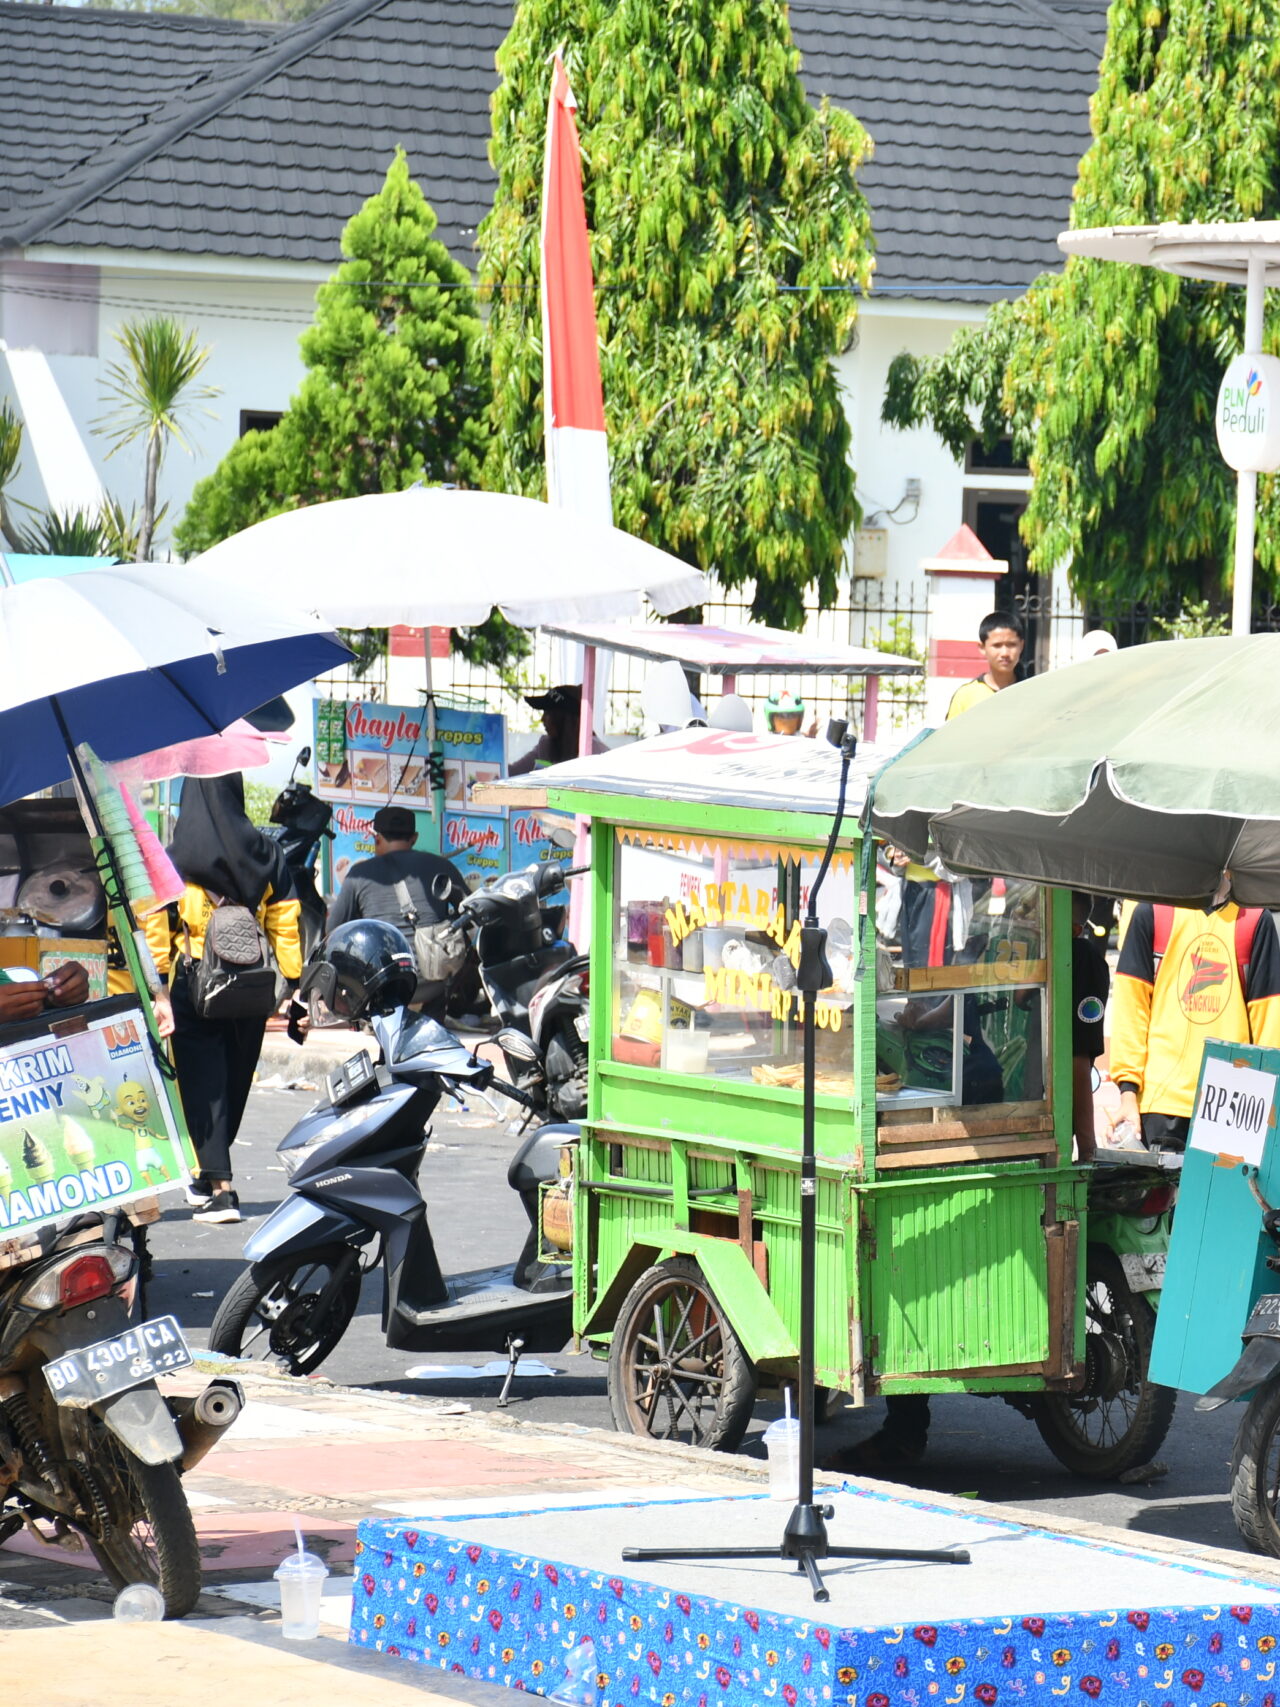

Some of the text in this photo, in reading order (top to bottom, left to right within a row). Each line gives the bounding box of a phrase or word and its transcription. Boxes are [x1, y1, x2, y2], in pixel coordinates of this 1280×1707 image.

[1223, 387, 1245, 407] PLN
[1222, 407, 1265, 434] Peduli
[703, 966, 773, 1011] MINI
[0, 1045, 74, 1090] KRIM
[0, 1082, 64, 1123] ENNY
[1200, 1084, 1265, 1134] RP 5000
[315, 1173, 353, 1189] HONDA
[49, 1323, 175, 1391] BD 4304 CA
